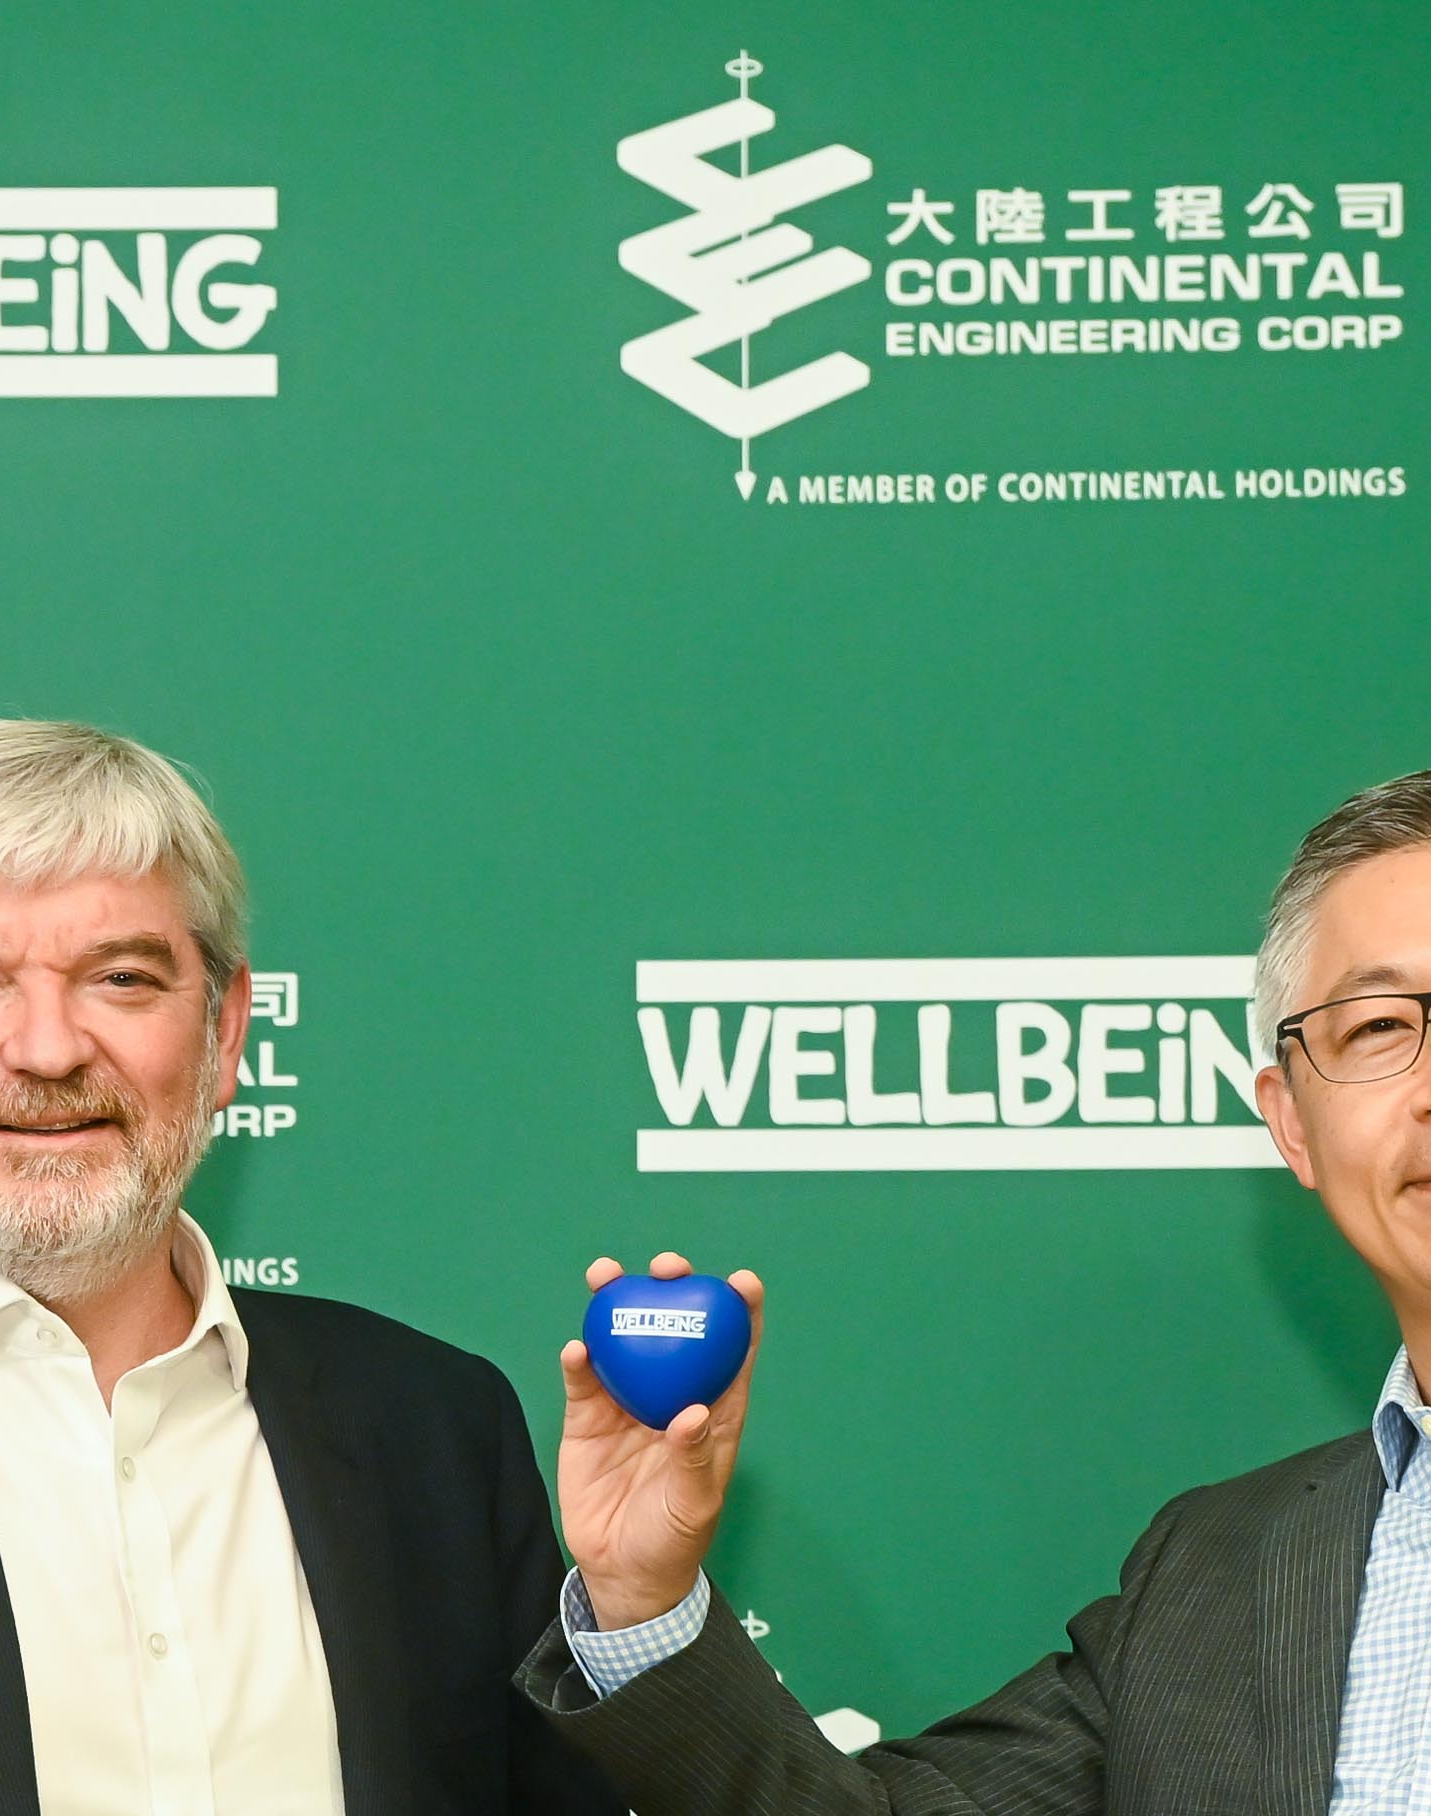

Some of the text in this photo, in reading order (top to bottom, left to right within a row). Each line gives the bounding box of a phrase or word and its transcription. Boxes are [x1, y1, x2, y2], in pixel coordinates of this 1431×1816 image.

[886, 182, 1404, 246] 大陸工程公司
[885, 251, 1404, 307] CONTINENTAL
[885, 314, 1403, 357] ENGINEERING CORP
[766, 466, 1407, 505] A MEMBER OF CONTINENTAL HOLDINGS
